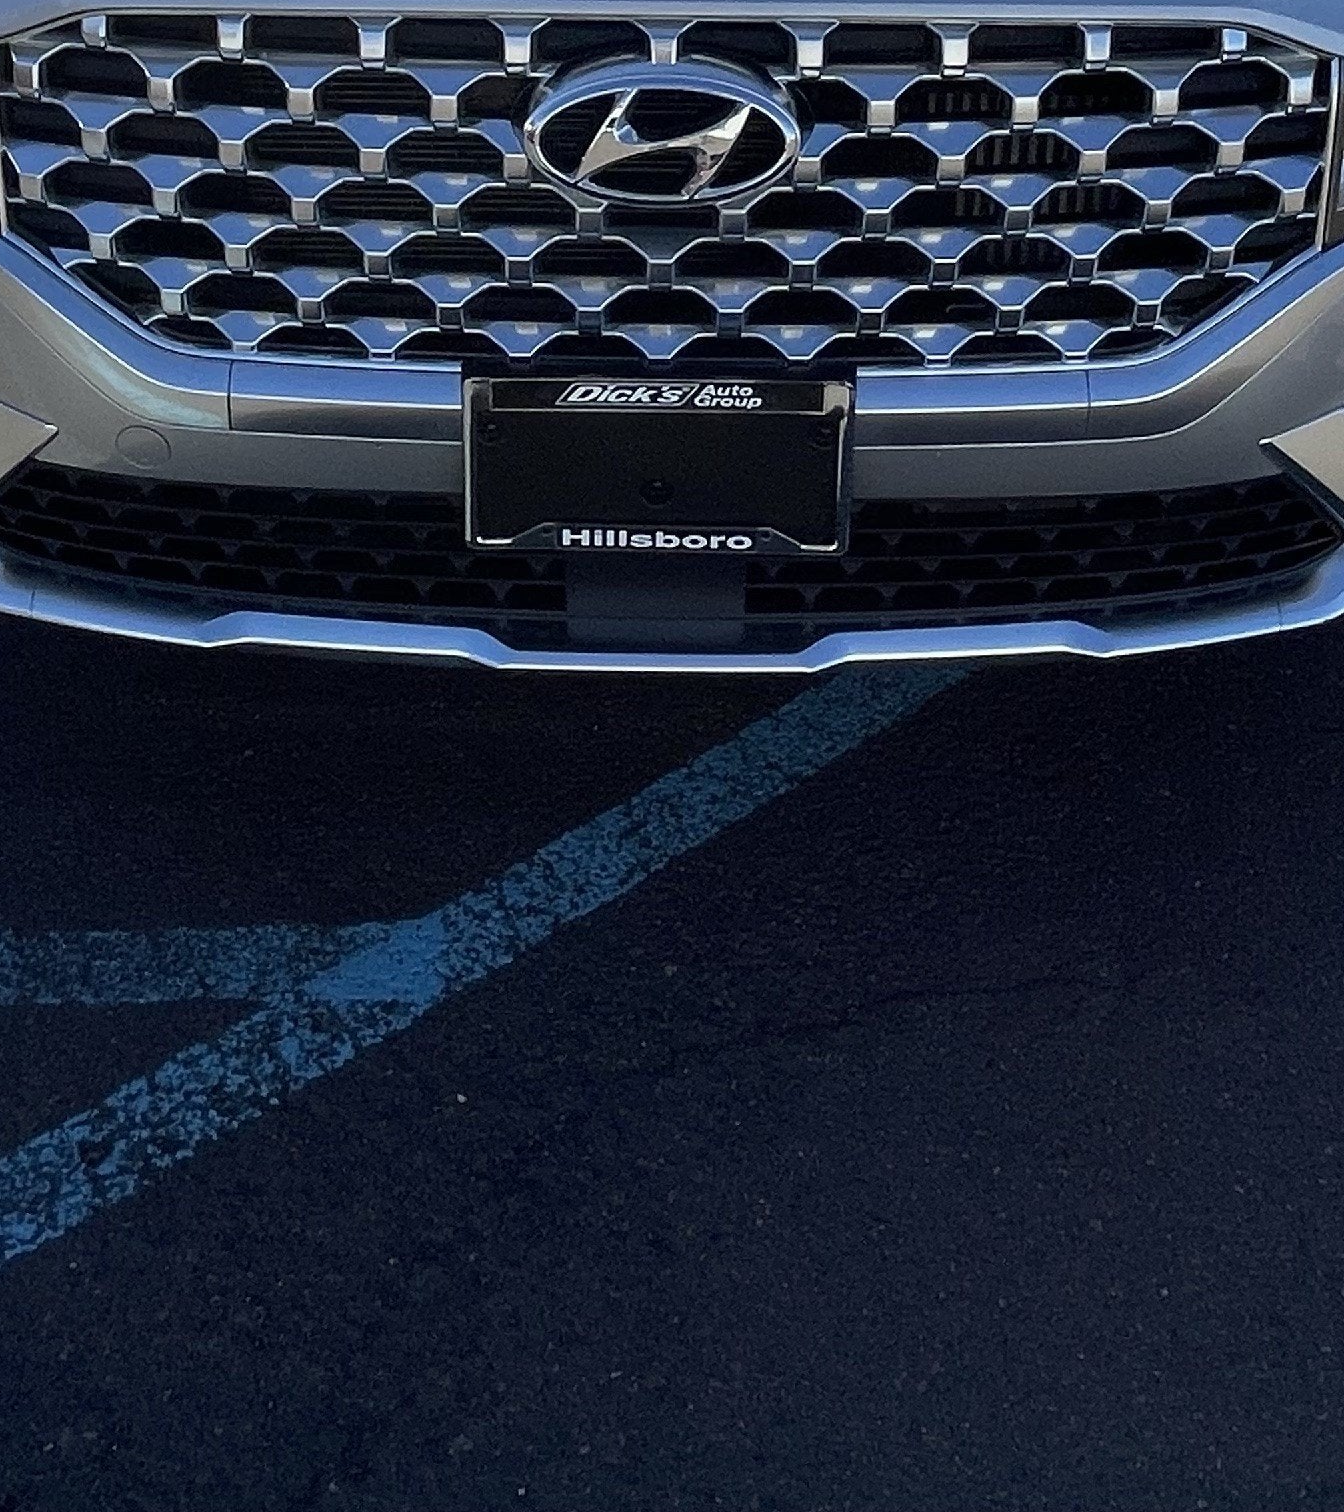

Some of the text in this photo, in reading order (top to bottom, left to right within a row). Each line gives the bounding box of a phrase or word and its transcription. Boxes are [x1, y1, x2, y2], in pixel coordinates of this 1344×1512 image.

[566, 384, 685, 403] Dick's
[700, 384, 754, 397] Auto
[693, 396, 763, 410] Group
[561, 527, 754, 550] Hillsboro
